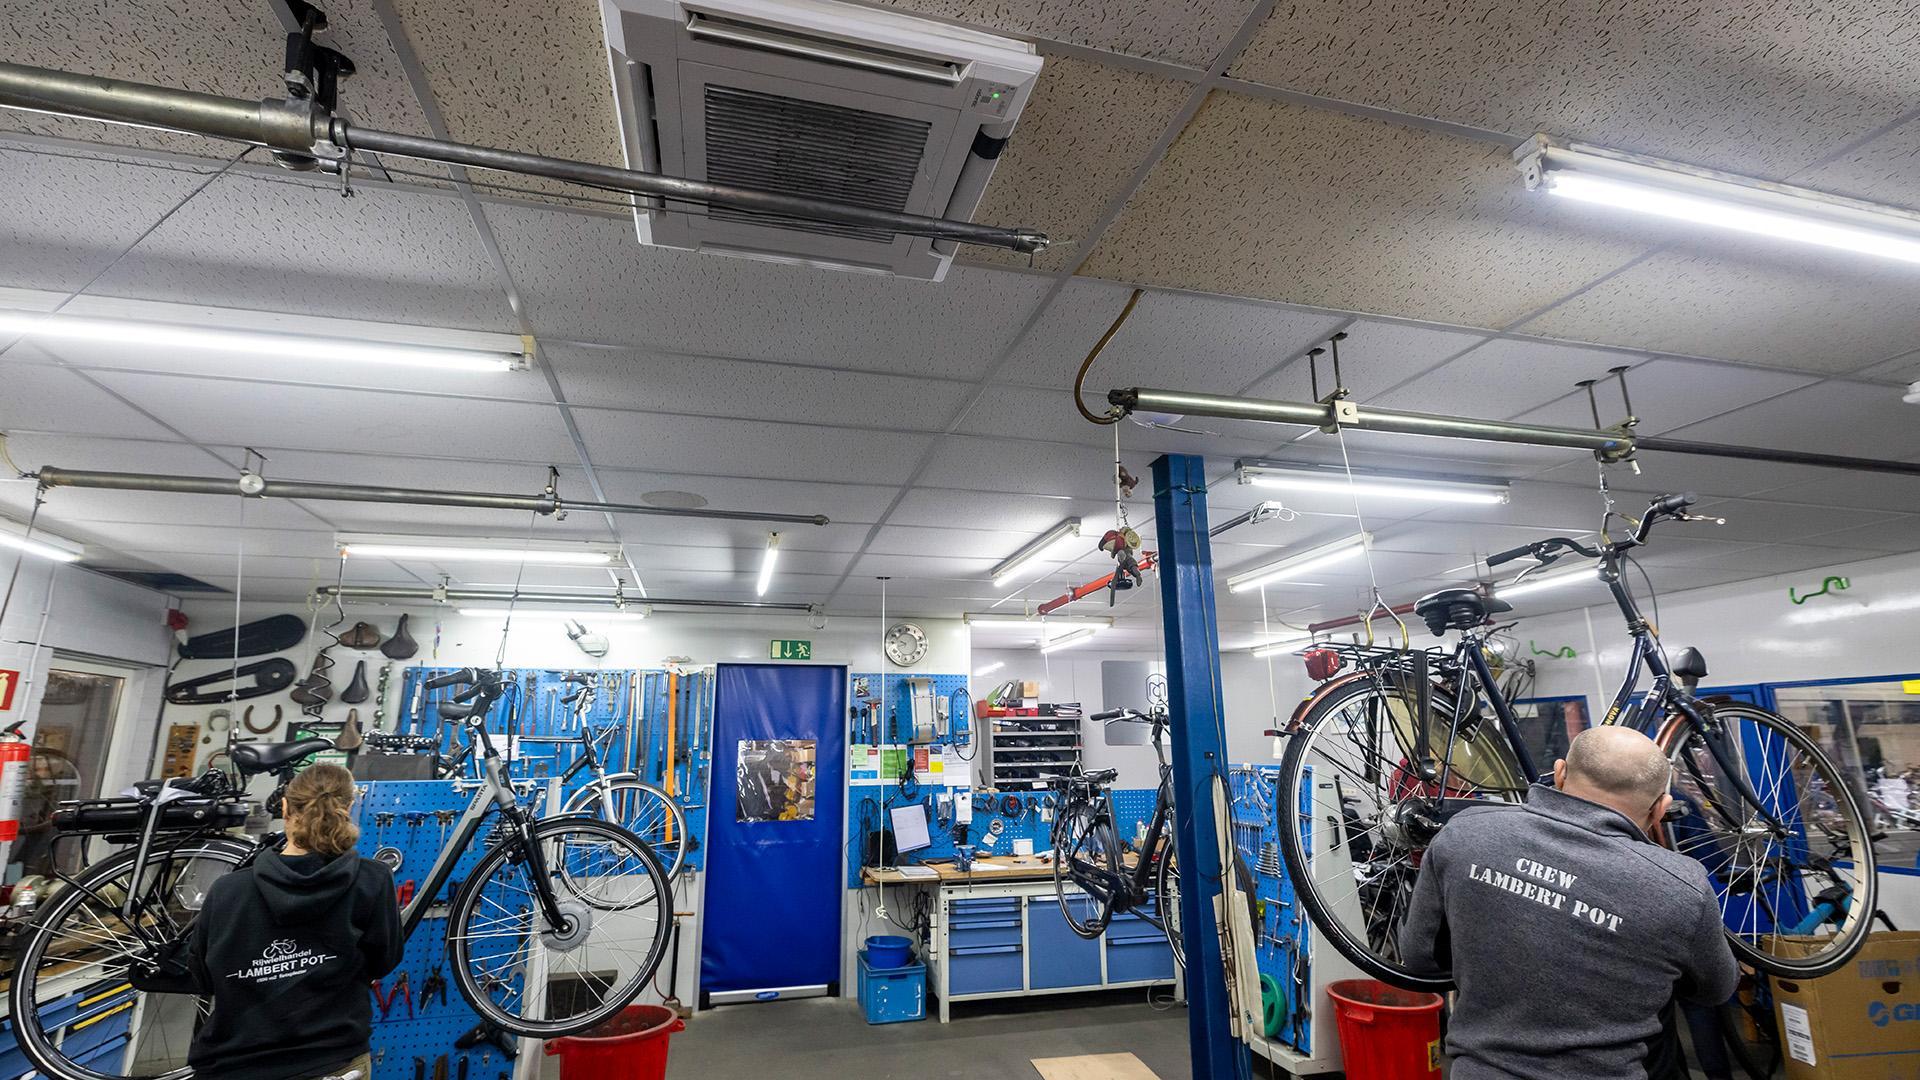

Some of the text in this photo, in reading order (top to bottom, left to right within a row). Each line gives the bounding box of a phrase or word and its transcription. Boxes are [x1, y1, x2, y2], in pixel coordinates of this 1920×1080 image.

[1516, 858, 1578, 889] CREW
[1469, 864, 1623, 932] LAMBERT POT
[238, 960, 298, 978] LAMBERT
[300, 954, 326, 967] POT
[252, 949, 311, 966] Rijwielhandel
